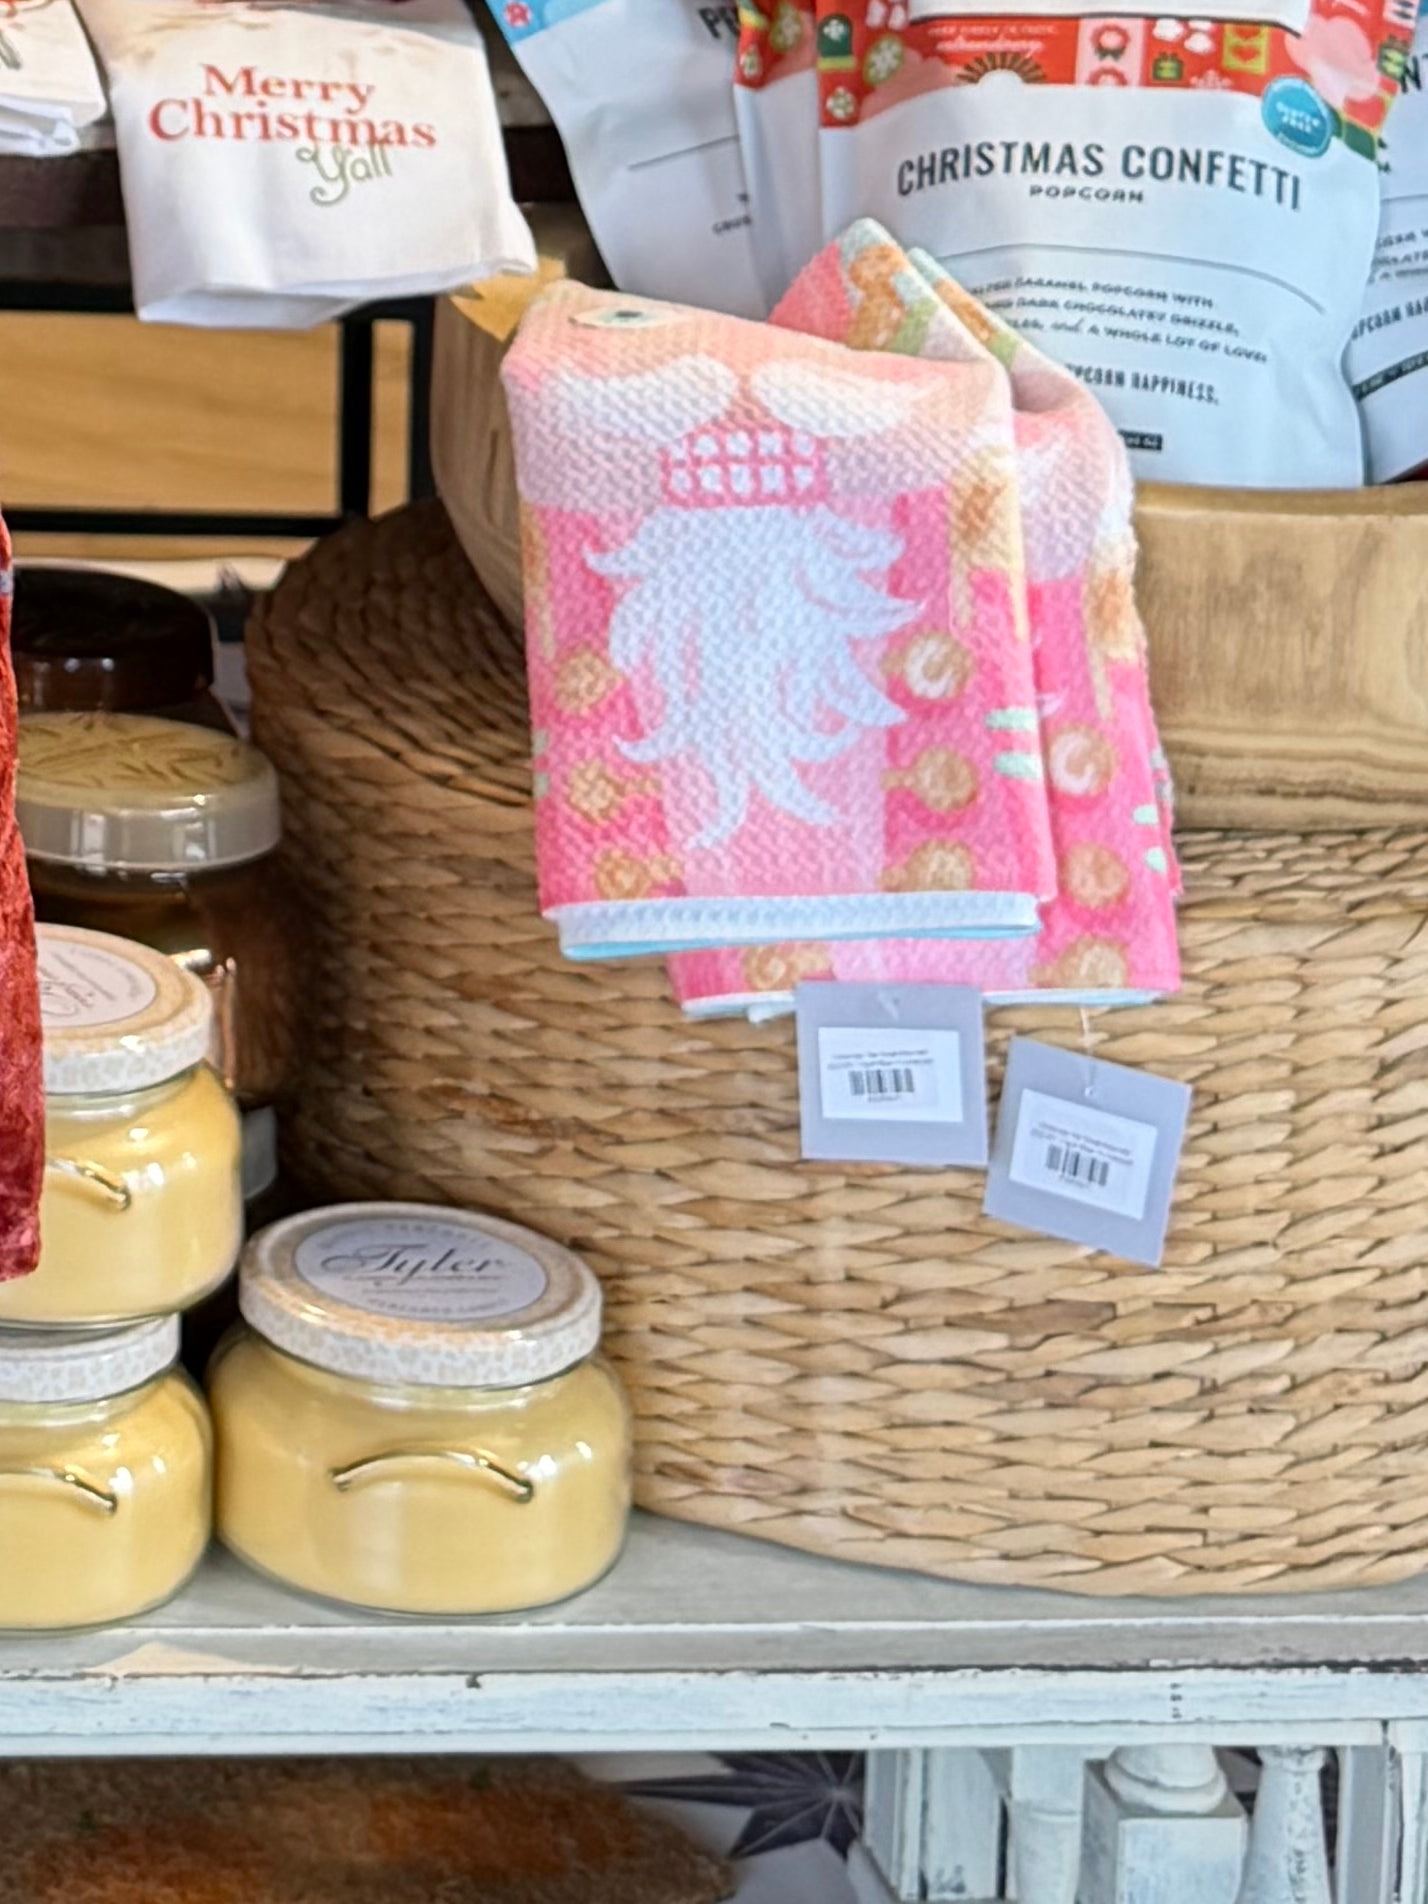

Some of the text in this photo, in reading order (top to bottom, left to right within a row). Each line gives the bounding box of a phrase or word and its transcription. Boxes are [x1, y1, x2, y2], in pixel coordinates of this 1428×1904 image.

[198, 62, 376, 114] Merry
[148, 98, 439, 149] Christmas
[896, 140, 1302, 211] CHRISTMAS CONFETTI
[1028, 184, 1144, 204] POPCORN
[319, 1243, 510, 1287] Tyler
